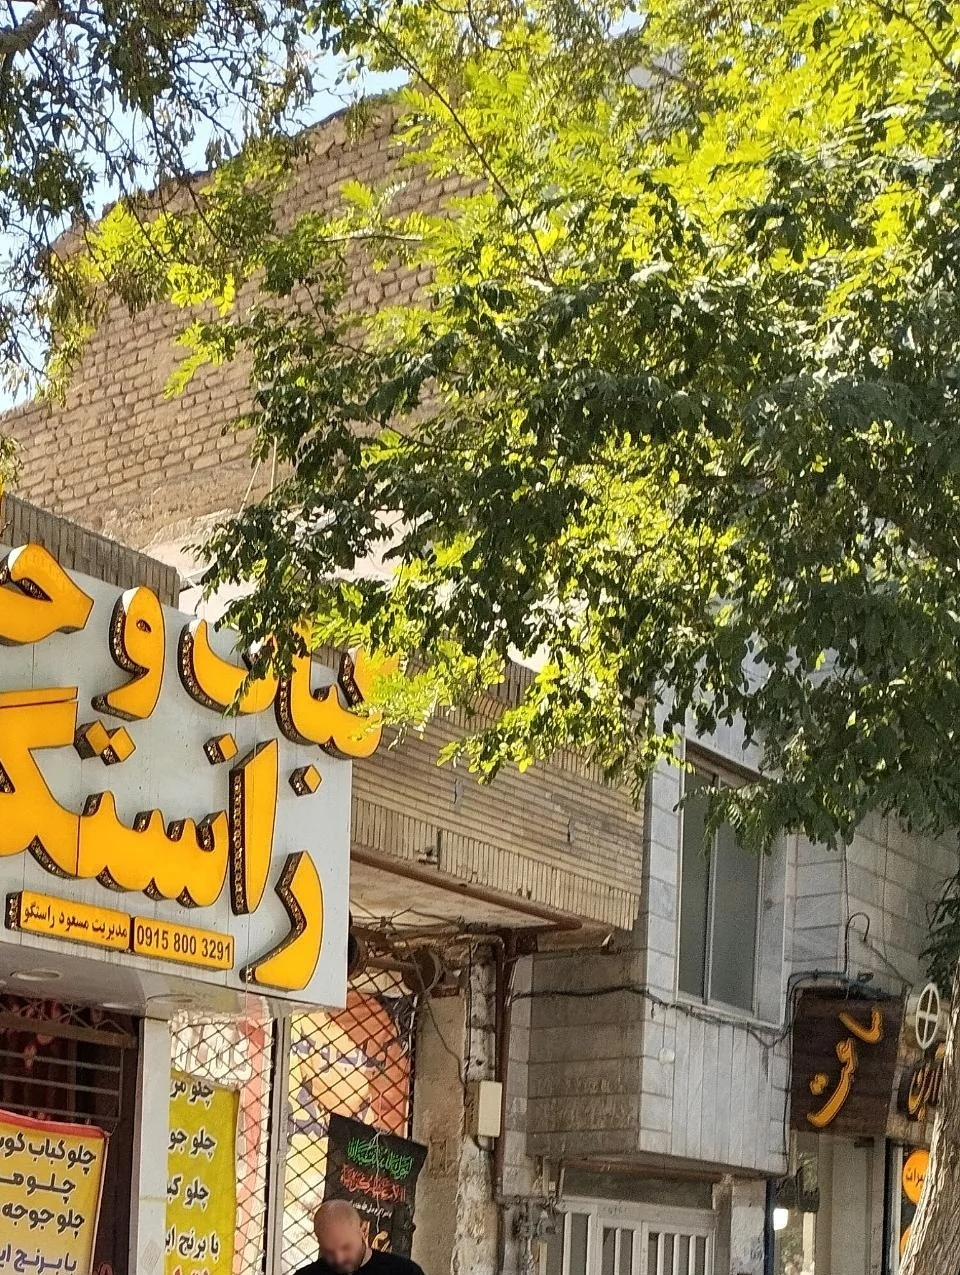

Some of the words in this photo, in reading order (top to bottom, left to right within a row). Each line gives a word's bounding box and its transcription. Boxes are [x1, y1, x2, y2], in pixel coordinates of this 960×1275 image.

[92, 586, 165, 721] و
[59, 910, 90, 932] مسعود
[91, 917, 128, 941] مدیریت
[136, 925, 169, 950] 0915
[174, 932, 197, 956] 800
[201, 938, 232, 964] 3291
[170, 1079, 188, 1098] مر
[167, 1129, 188, 1152] جو
[191, 1129, 216, 1161] چلو
[68, 1145, 97, 1175] چلو
[186, 1178, 210, 1210] چلو
[2, 1202, 55, 1230] جوجه
[57, 1209, 85, 1239] چلو
[13, 1249, 63, 1275] برنج
